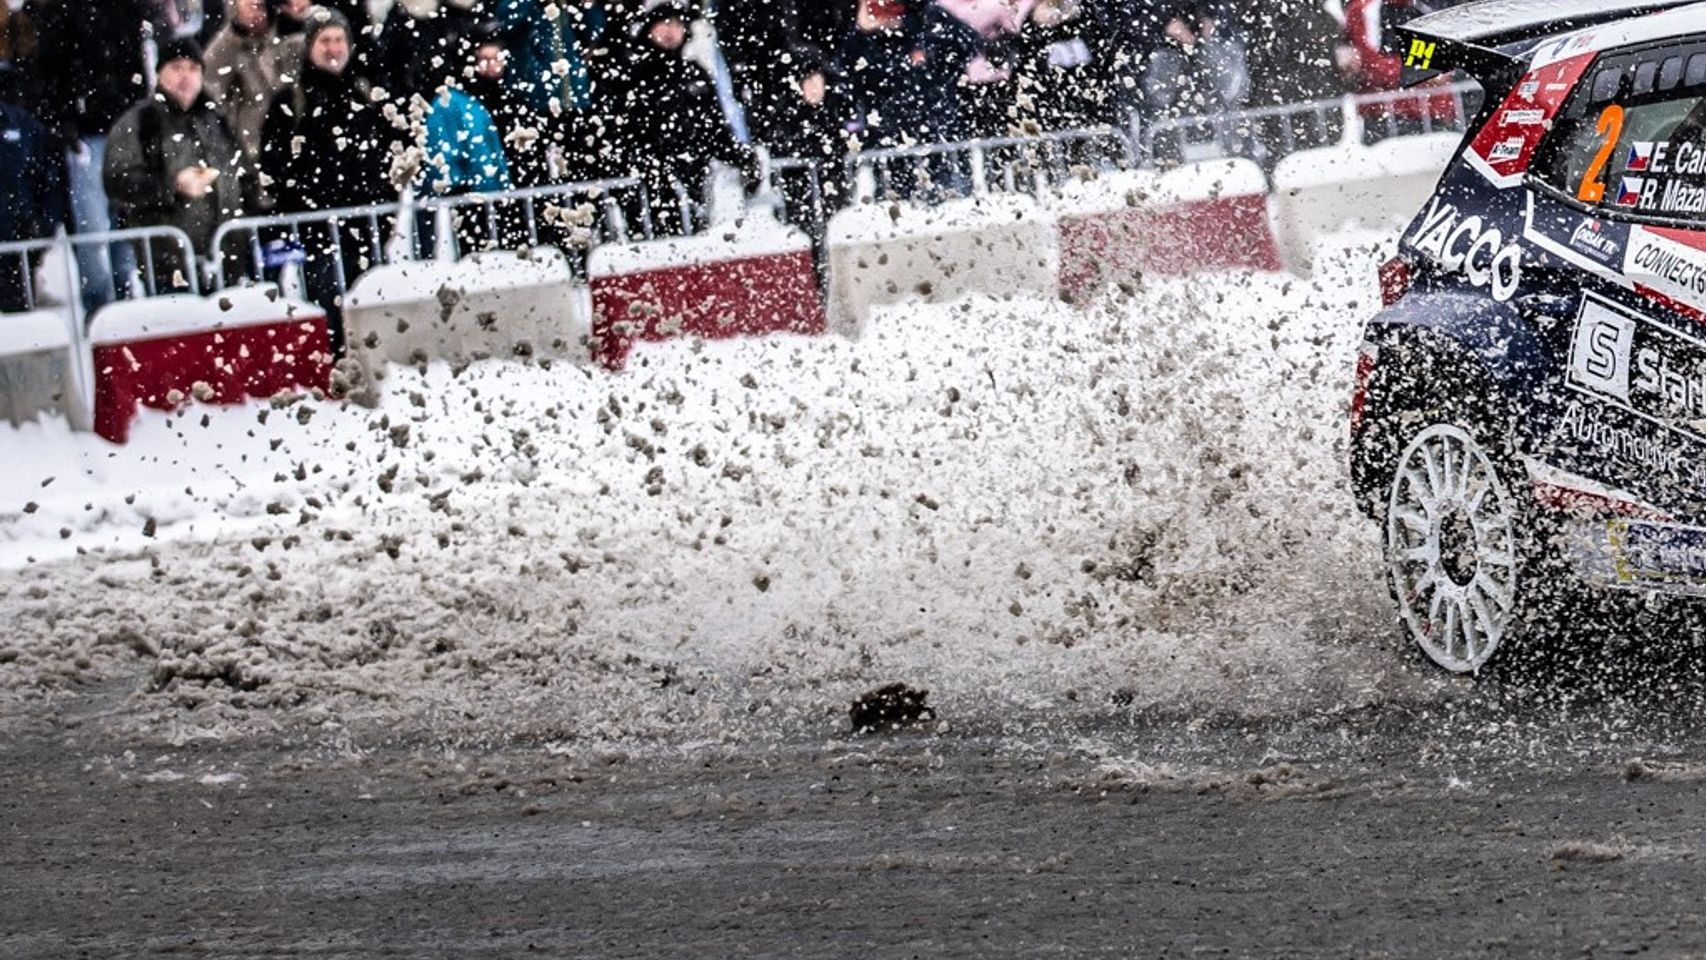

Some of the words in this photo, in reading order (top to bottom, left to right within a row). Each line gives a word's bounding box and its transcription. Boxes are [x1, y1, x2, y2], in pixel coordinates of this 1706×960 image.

[1578, 102, 1625, 202] 2
[1651, 142, 1668, 173] E.
[1641, 184, 1658, 210] R.
[1412, 197, 1522, 302] YACCO
